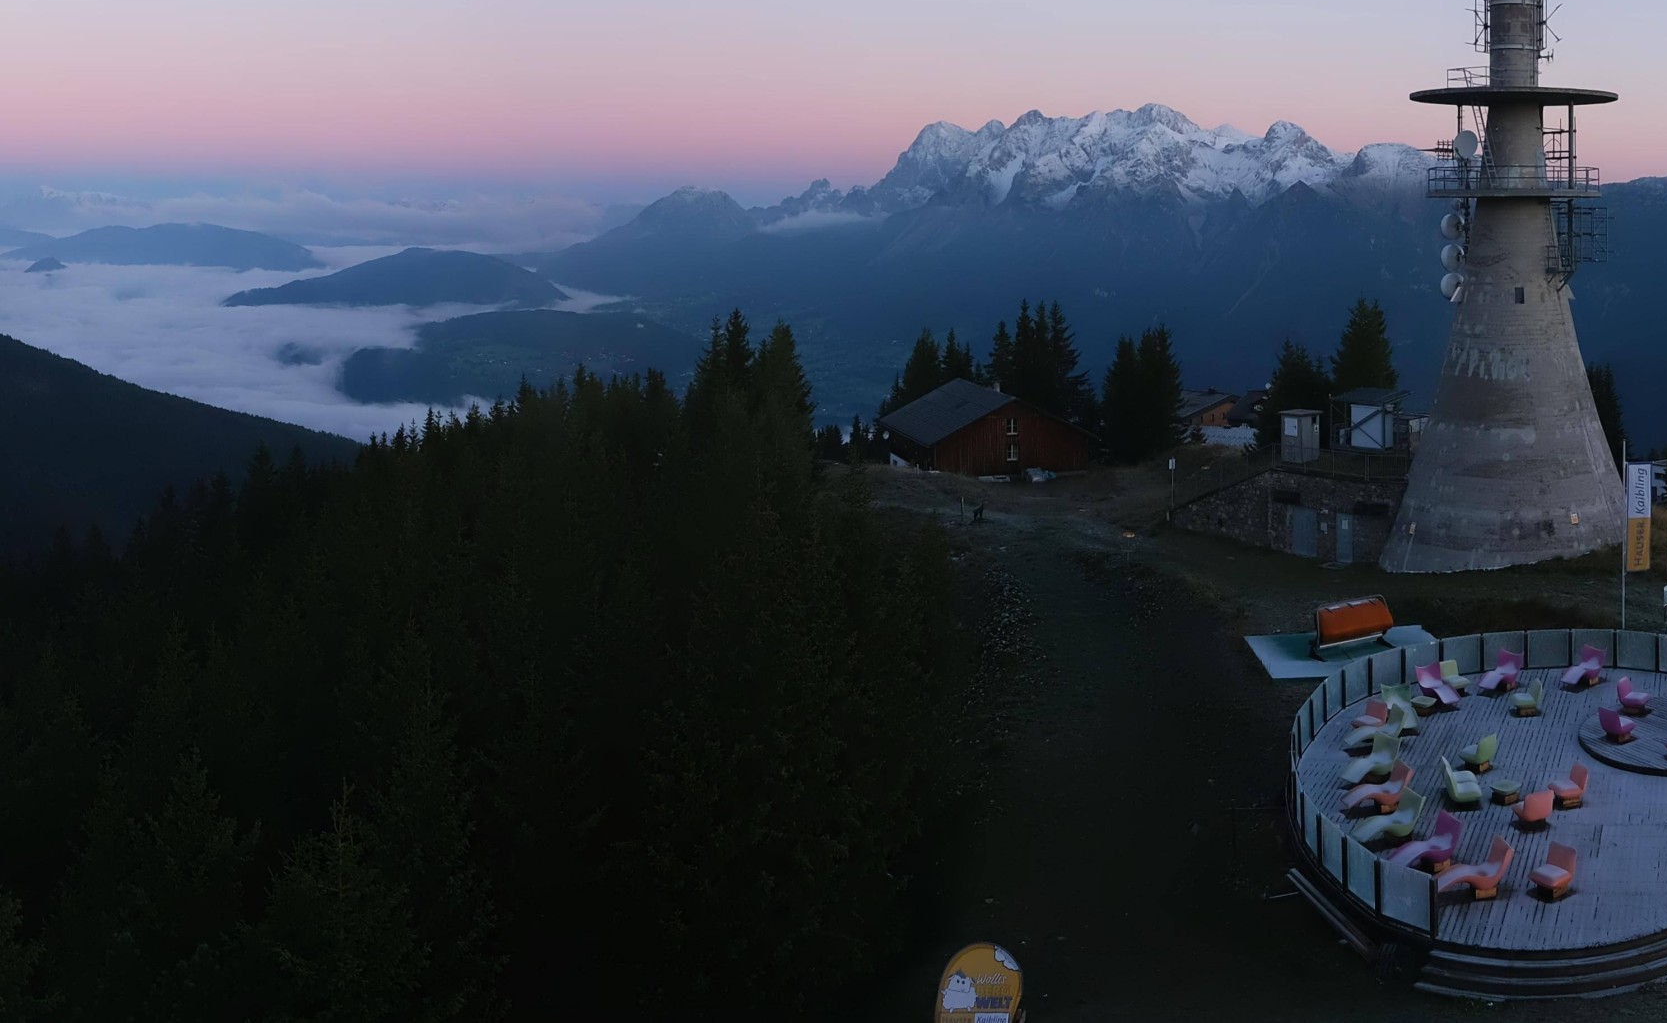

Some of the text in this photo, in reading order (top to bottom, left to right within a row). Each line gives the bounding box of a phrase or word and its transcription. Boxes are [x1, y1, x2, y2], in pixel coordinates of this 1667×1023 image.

[1634, 467, 1648, 566] HAUSER Kaibling
[975, 996, 1012, 1009] WELT
